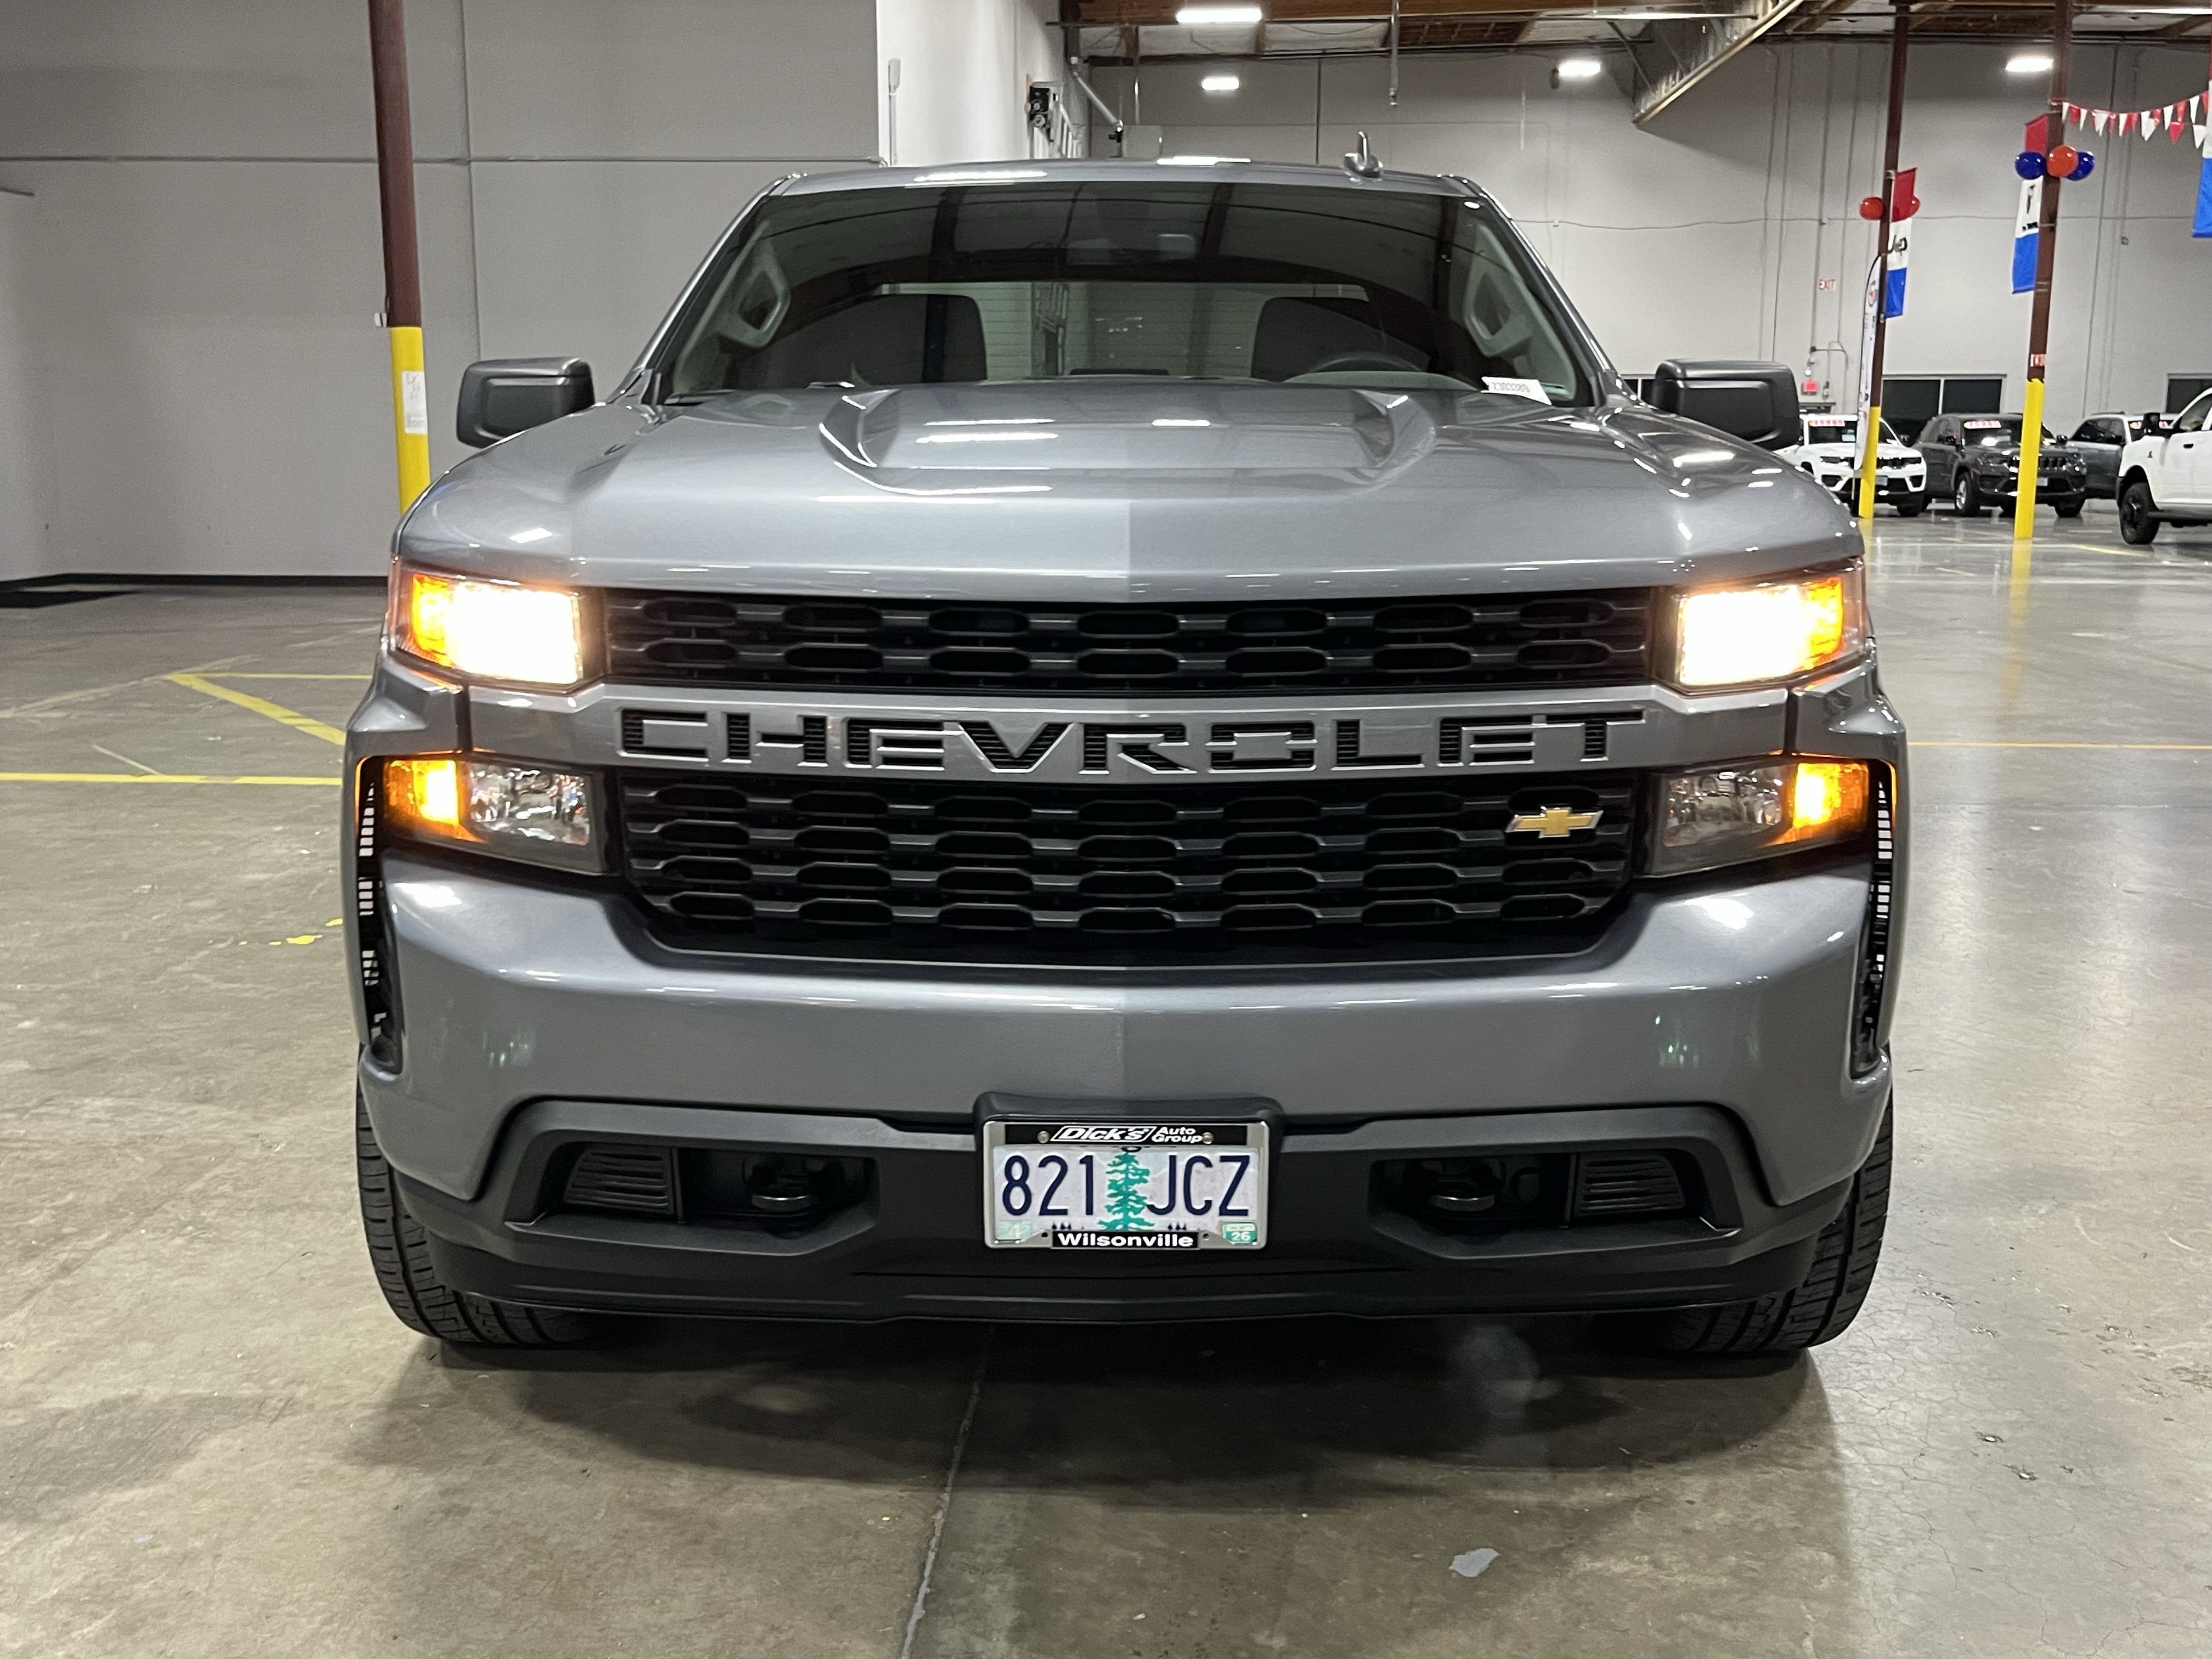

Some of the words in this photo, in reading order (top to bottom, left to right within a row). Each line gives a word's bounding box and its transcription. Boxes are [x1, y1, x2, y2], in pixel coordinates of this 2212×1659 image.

[619, 708, 1645, 775] CHEVROLET
[1058, 1127, 1144, 1141] Dick's
[1155, 1126, 1196, 1135] Auto
[1151, 1133, 1203, 1144] Group
[1002, 1154, 1094, 1216] 821
[1146, 1154, 1250, 1217] JCZ
[1057, 1232, 1194, 1247] Wilsonville
[1231, 1231, 1251, 1241] 26
